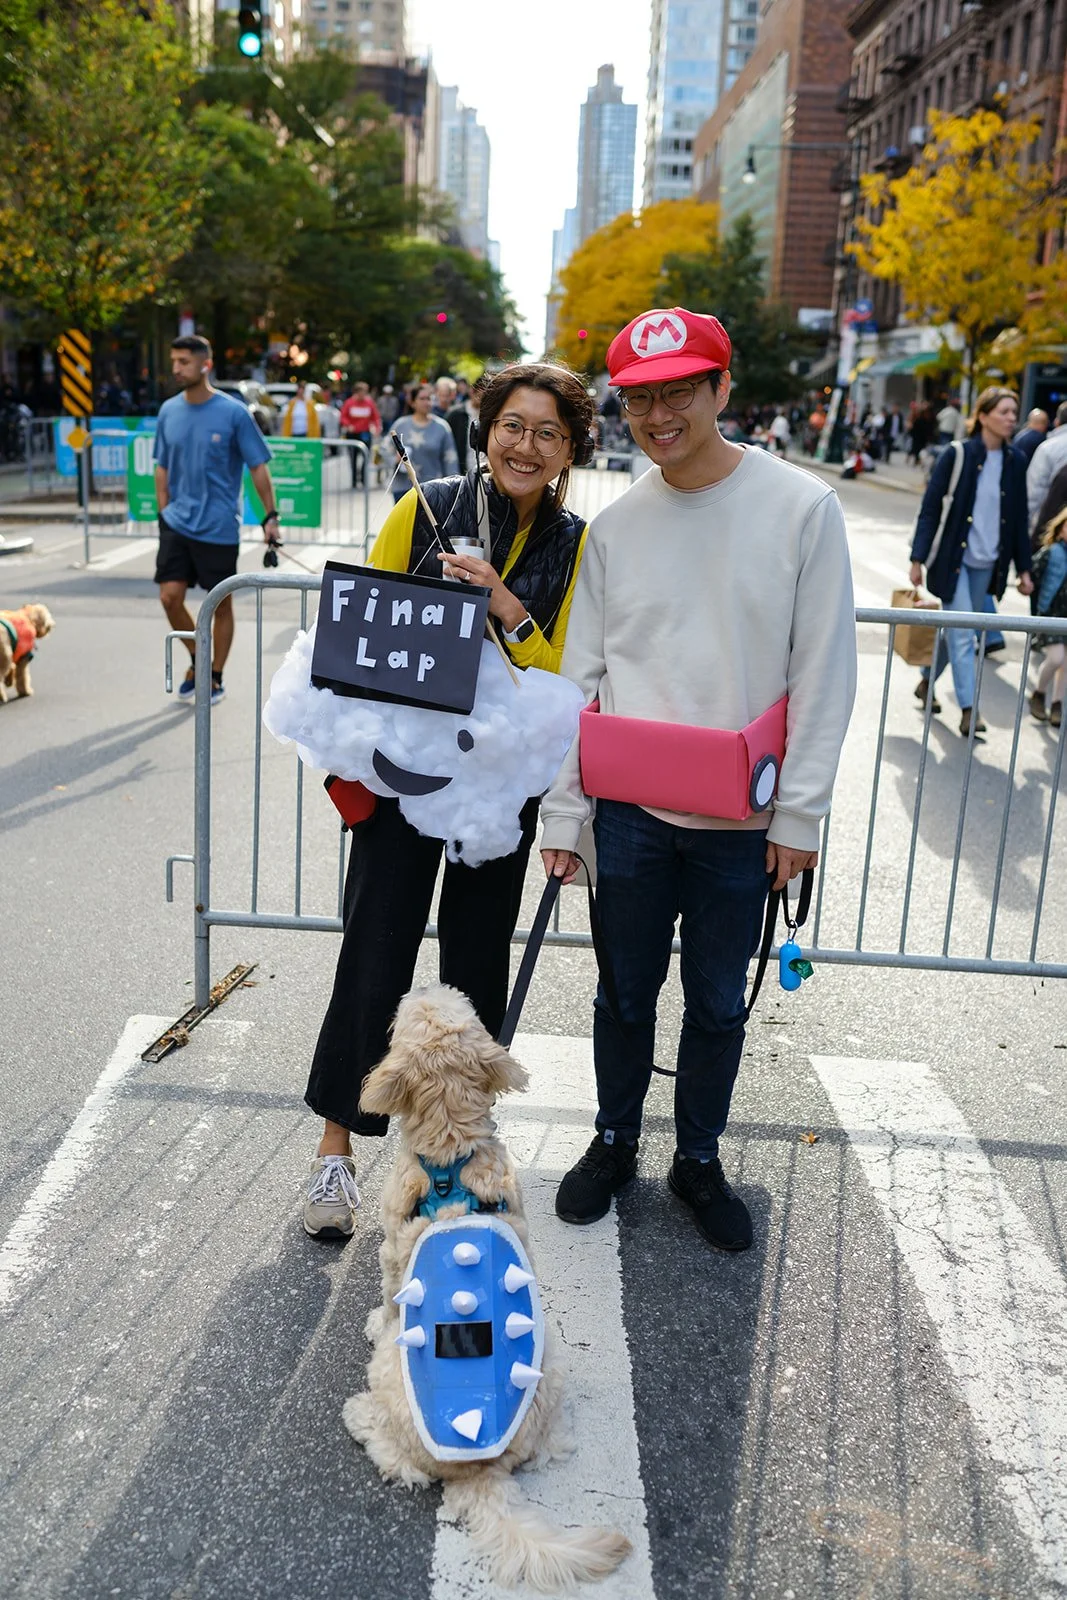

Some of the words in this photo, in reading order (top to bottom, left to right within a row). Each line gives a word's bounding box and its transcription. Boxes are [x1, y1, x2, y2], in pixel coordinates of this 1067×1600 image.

[637, 317, 683, 351] M
[332, 579, 477, 639] Final
[355, 636, 436, 683] Lap
